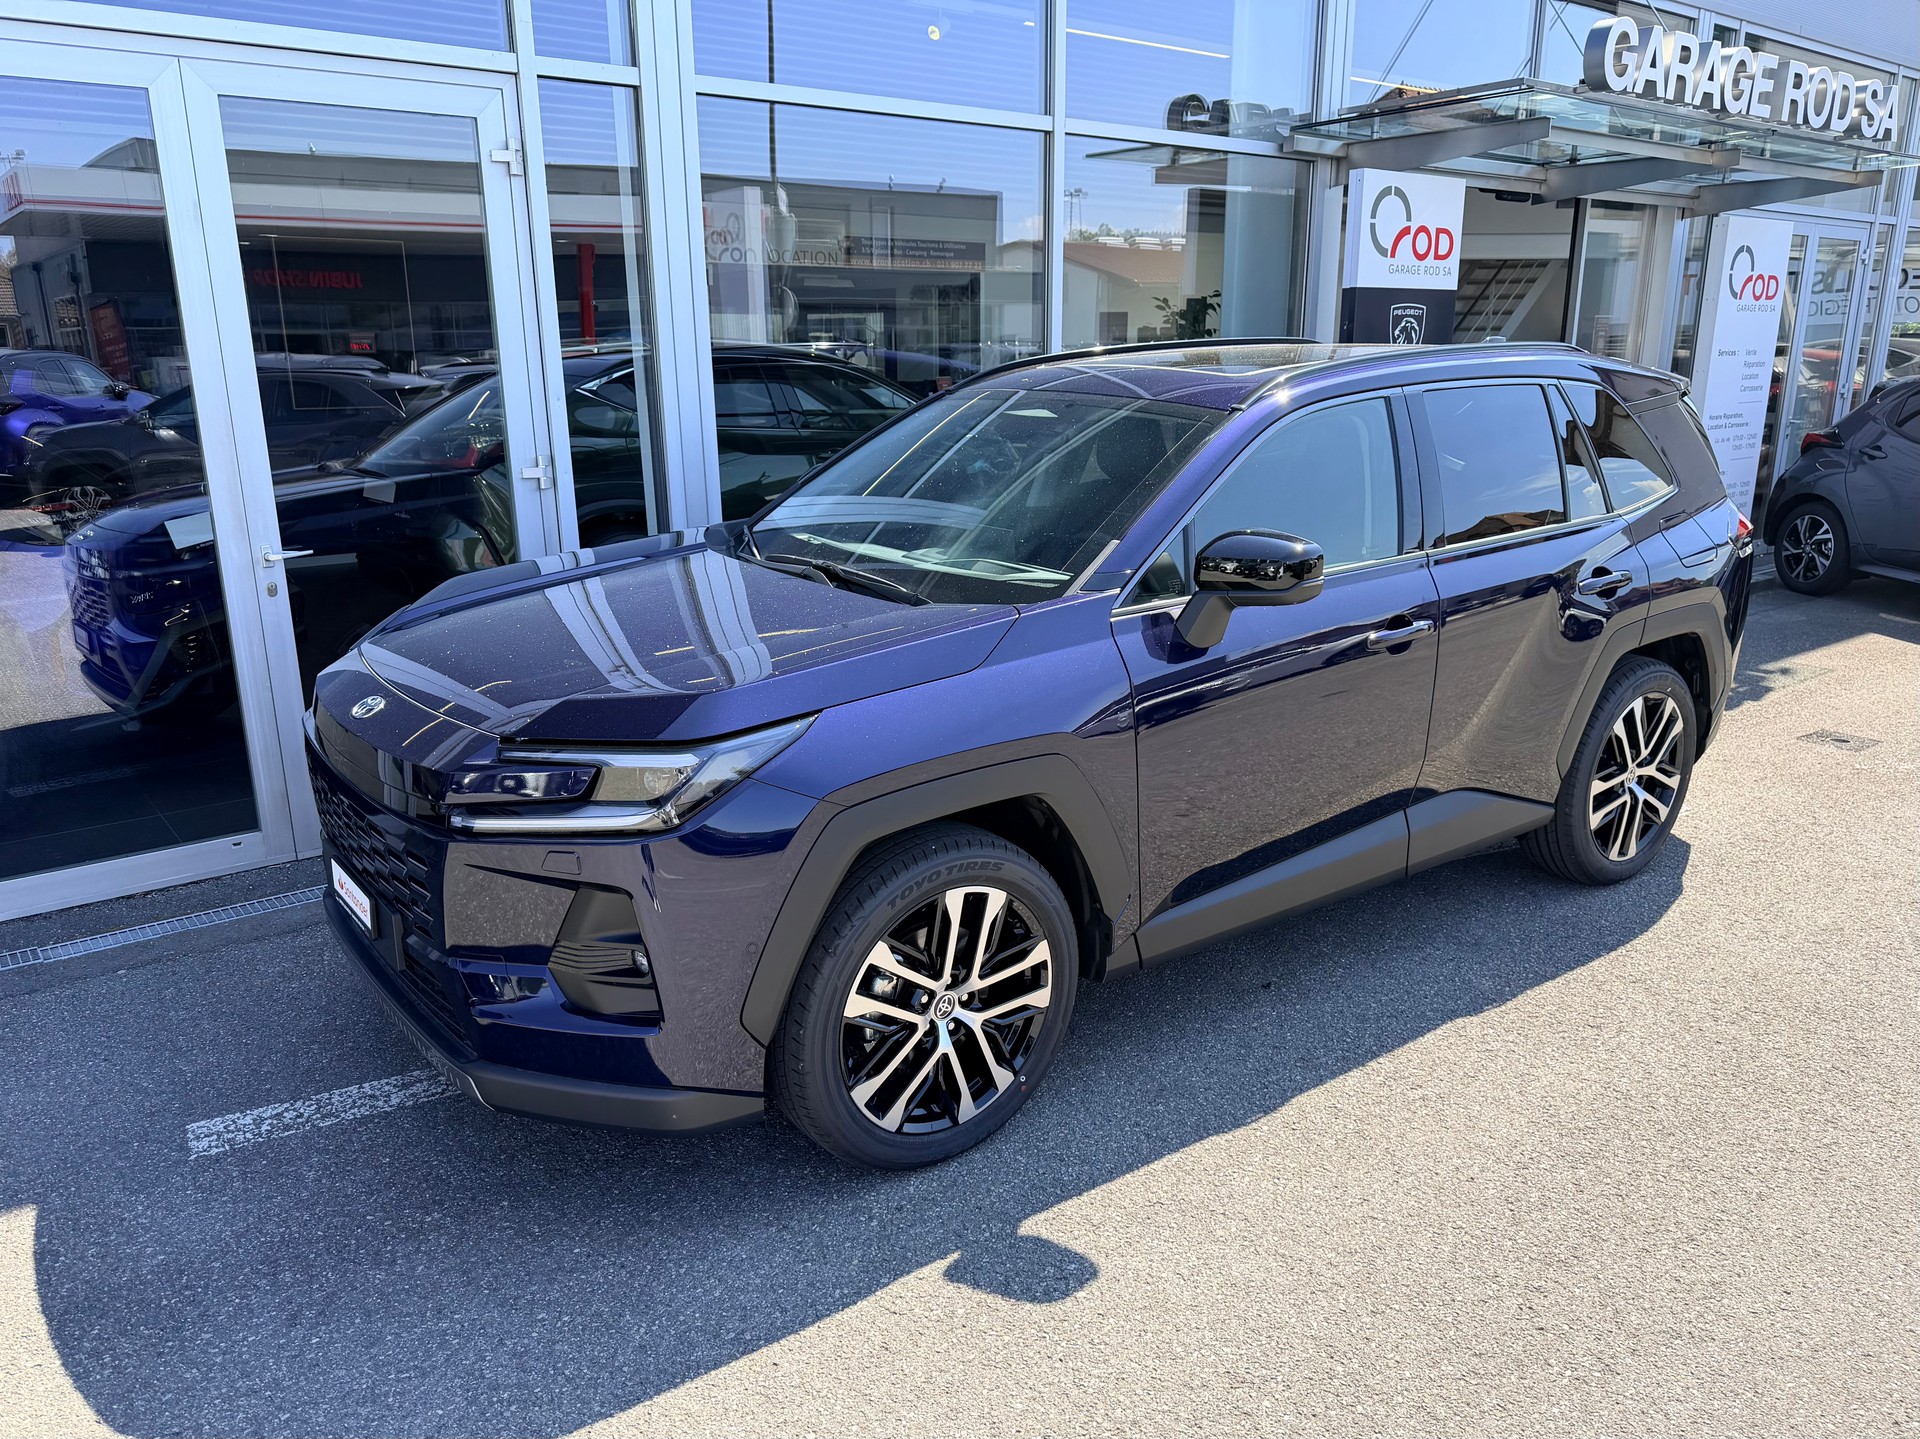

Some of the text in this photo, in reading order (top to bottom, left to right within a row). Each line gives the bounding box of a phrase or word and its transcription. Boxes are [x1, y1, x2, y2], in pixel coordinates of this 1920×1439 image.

[1600, 15, 1899, 142] GARAGE ROD SA
[1388, 263, 1452, 277] GARAGE ROD SA
[1393, 308, 1424, 317] PEUGEOT
[1737, 303, 1757, 313] GARAGE
[1757, 304, 1769, 313] ROD
[1743, 360, 1766, 369] Réparation
[1741, 372, 1760, 381] Location
[886, 860, 1006, 911] TOYO TIRES
